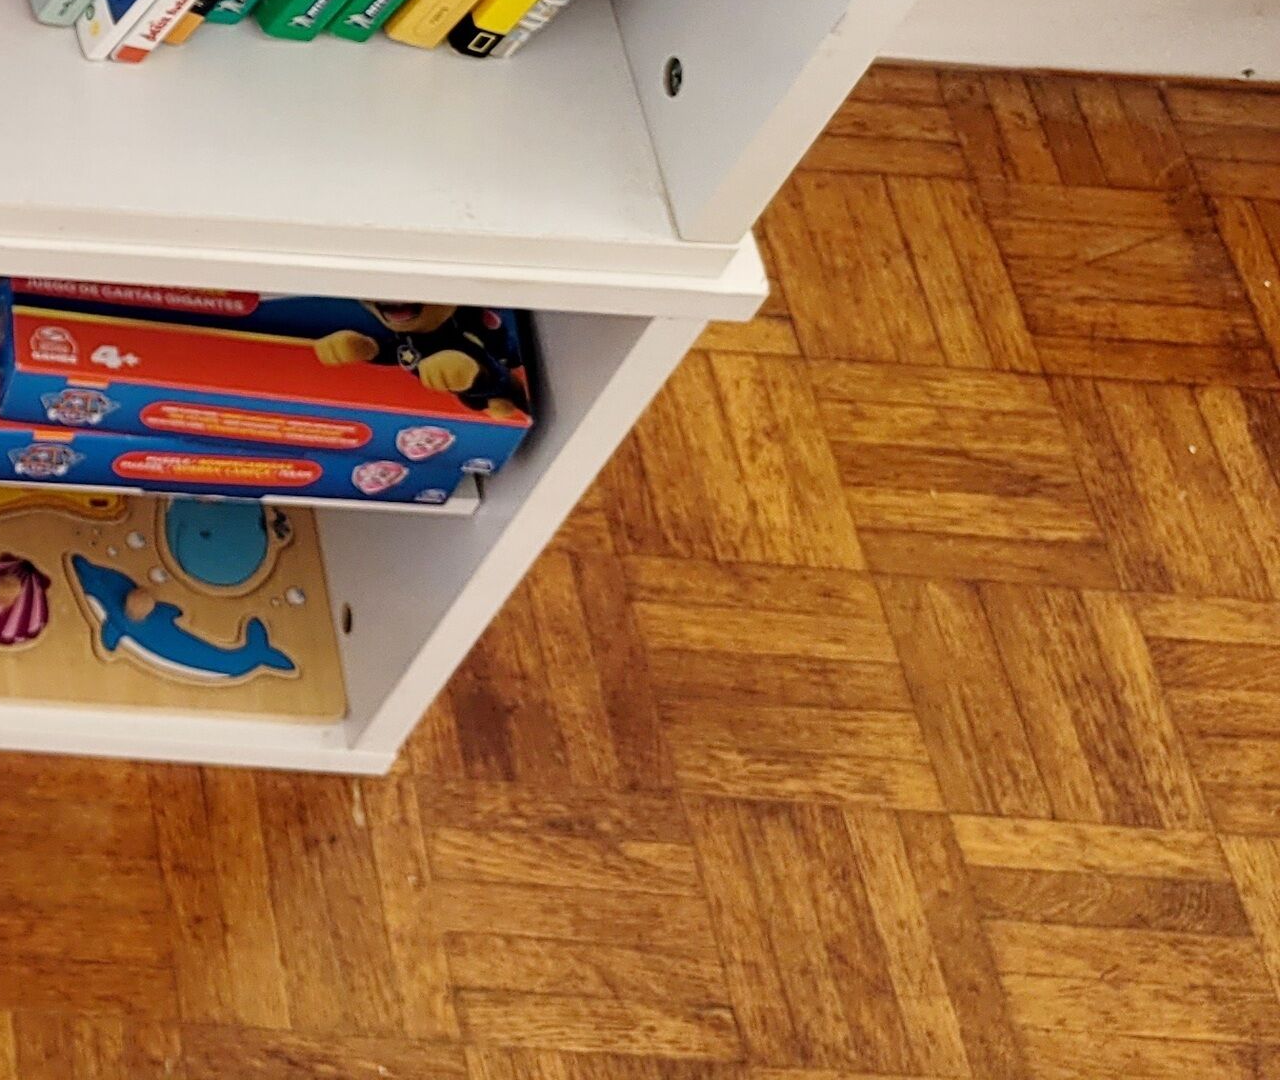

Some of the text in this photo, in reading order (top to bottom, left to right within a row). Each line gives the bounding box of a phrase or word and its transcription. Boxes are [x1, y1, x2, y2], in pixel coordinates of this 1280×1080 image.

[27, 278, 245, 312] JUEGO DE CARTAS GIGANTES
[91, 345, 140, 370] 4+
